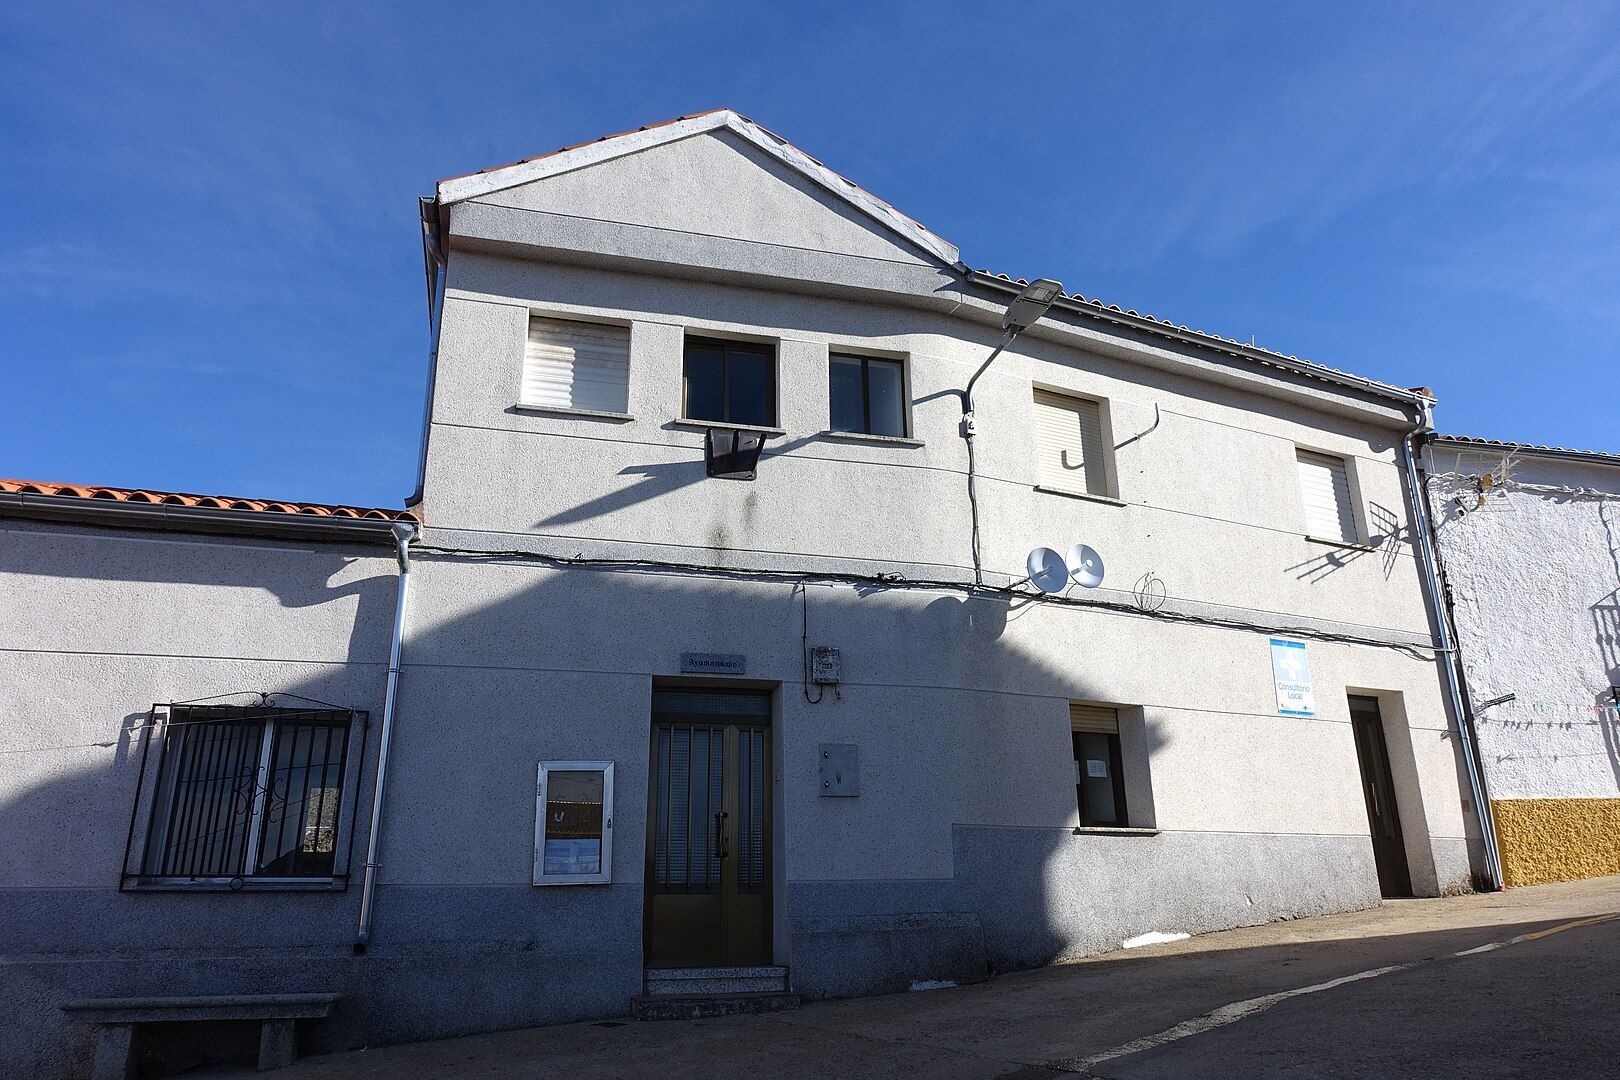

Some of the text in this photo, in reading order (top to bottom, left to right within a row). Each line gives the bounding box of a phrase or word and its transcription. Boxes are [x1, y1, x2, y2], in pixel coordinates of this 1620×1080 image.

[688, 658, 738, 668] Ayuntamiento
[1278, 682, 1311, 693] Consultorio
[1287, 691, 1303, 700] Local
